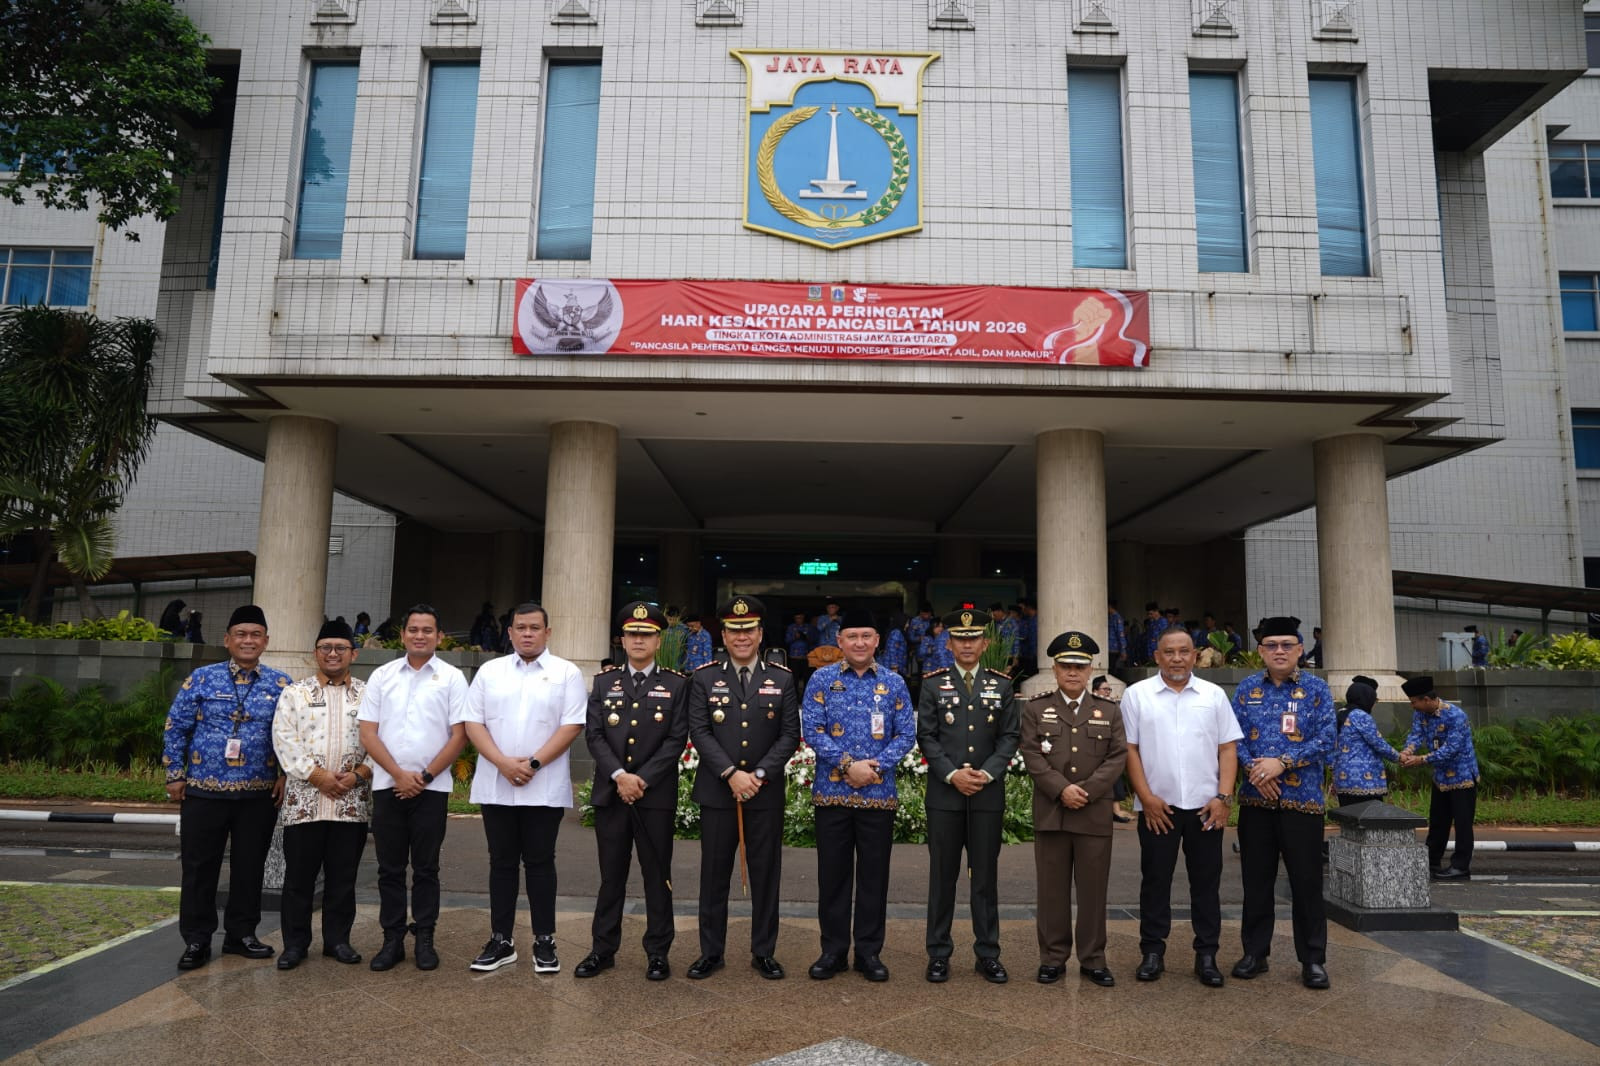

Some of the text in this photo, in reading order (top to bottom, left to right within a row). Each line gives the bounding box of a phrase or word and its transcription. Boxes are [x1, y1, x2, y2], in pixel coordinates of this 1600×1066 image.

[766, 56, 903, 74] JAYA RAYA
[744, 303, 944, 319] UPACARA PERINGATAN
[661, 314, 1027, 334] HARI KESAKTIAN PANCASILA TAHUN 2026
[713, 331, 948, 344] TINGKAT KOTA ADMINISTRASI JAKARTA UTARA
[630, 341, 688, 350] "PANCASILA
[691, 342, 749, 351] PEMERSATU
[751, 344, 791, 353] BANGSA
[794, 345, 834, 354] MENUJU
[837, 346, 893, 355] INDONESIA
[893, 347, 953, 357] BERDAULAT,
[955, 348, 980, 358] ADIL,
[982, 349, 1003, 358] DAN
